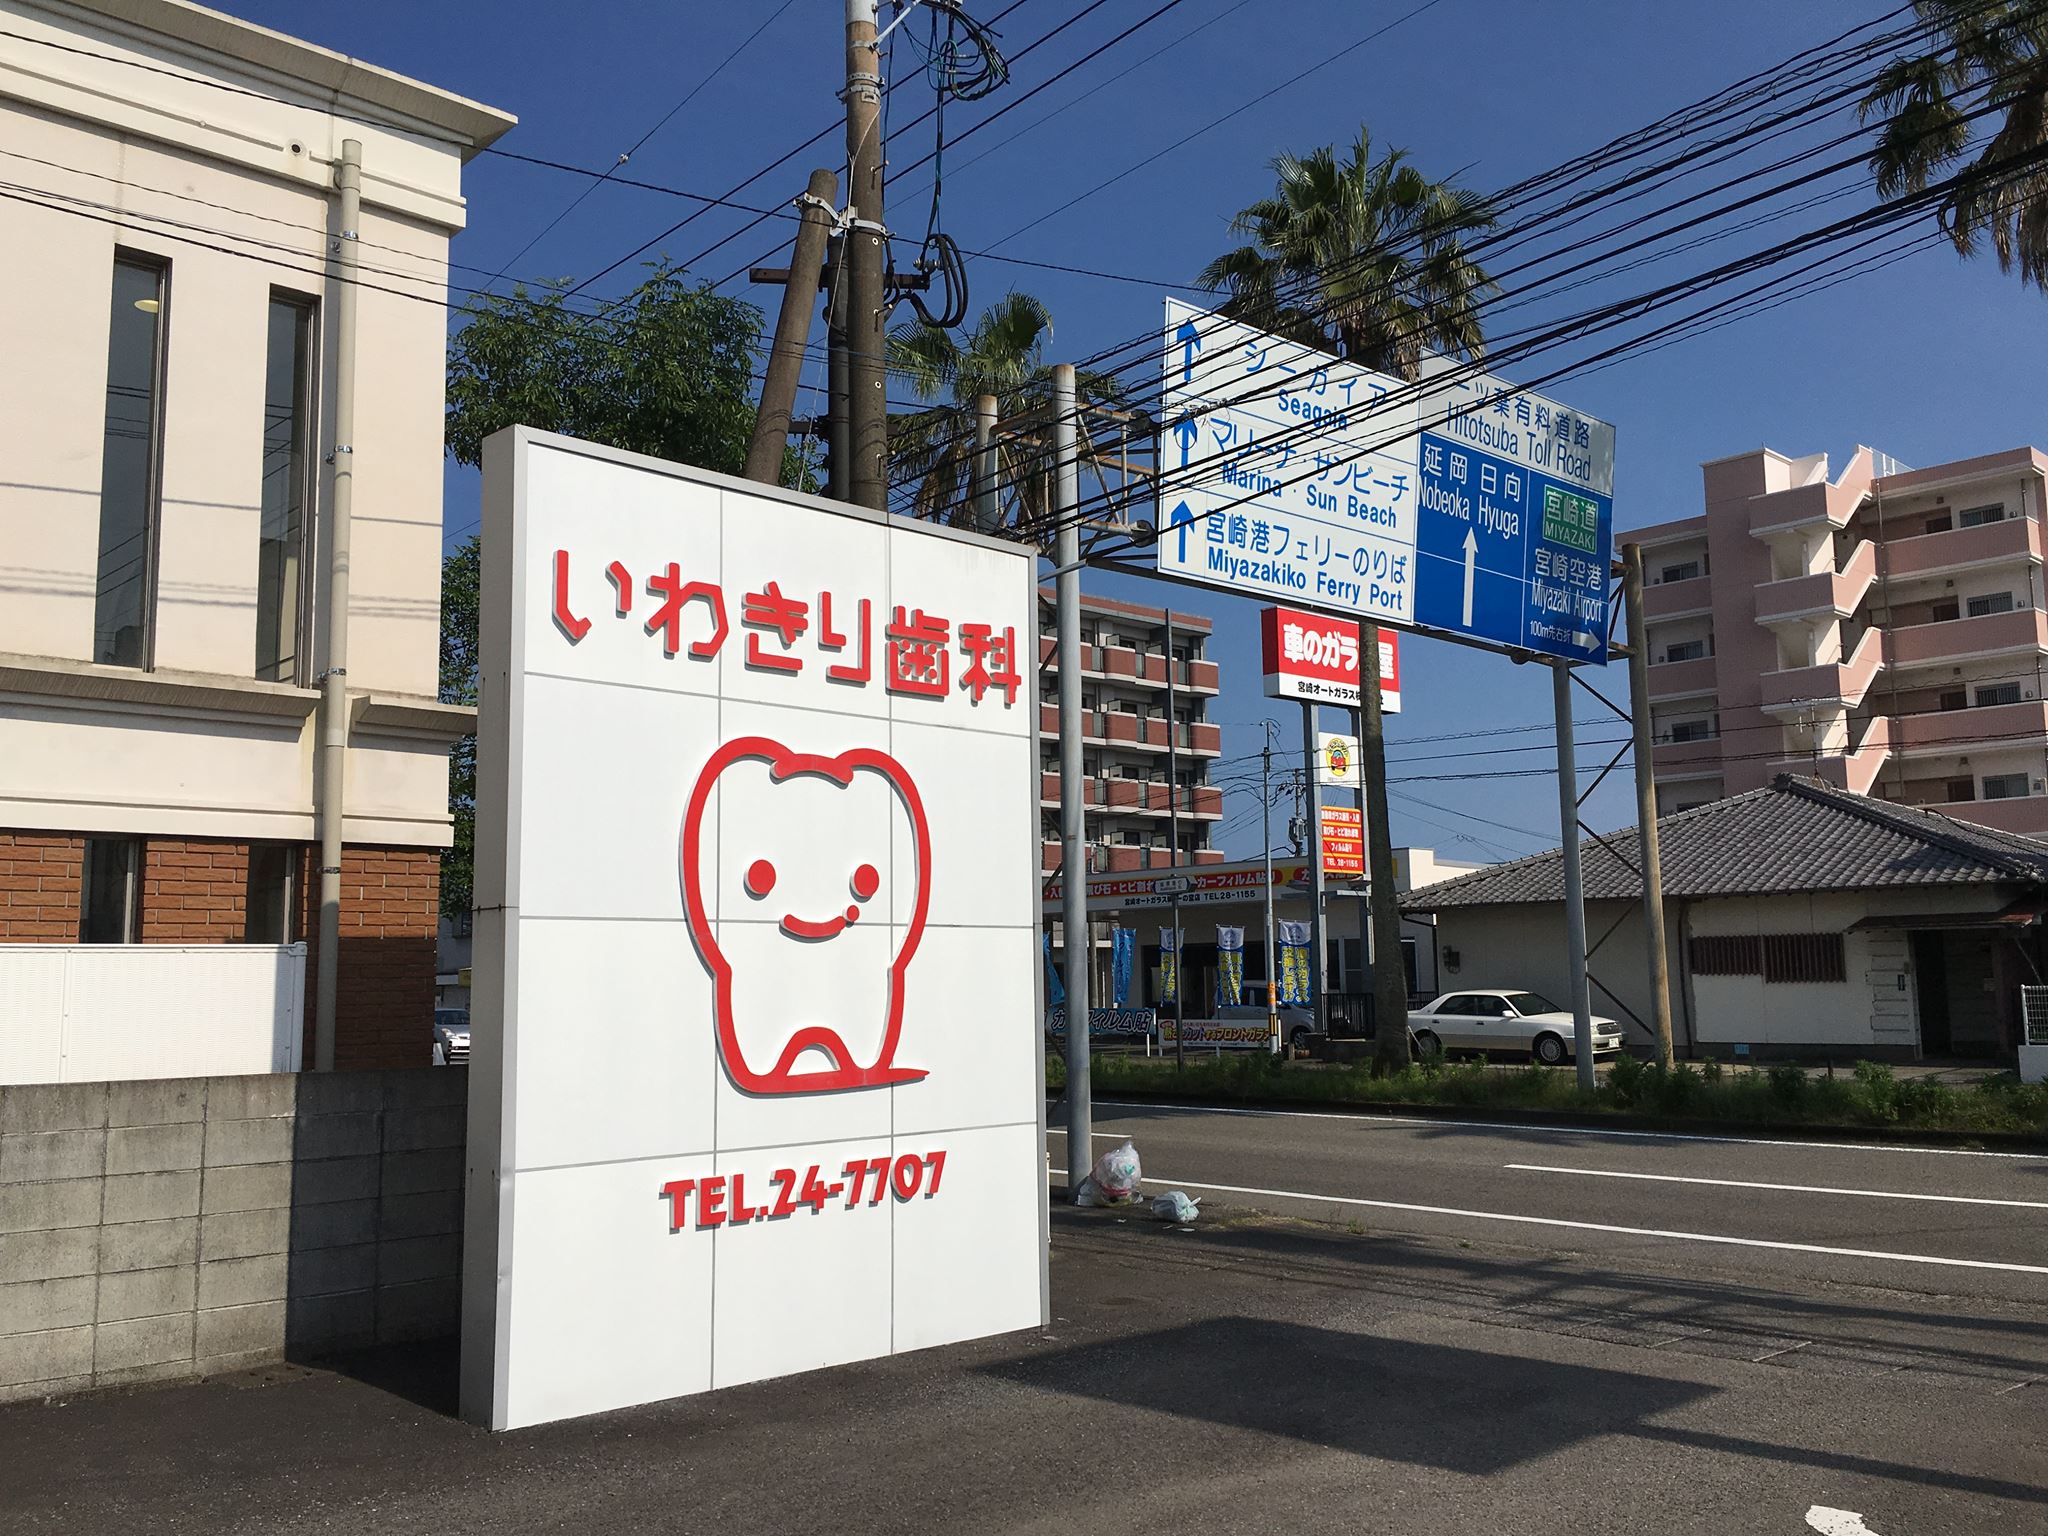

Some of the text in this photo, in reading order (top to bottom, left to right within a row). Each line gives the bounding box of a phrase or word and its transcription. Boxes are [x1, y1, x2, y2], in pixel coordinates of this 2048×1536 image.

[1244, 342, 1388, 408] シーガイア
[1278, 388, 1348, 432] Seagaia
[1447, 401, 1592, 482] Hitotsuba Toll Road
[1453, 378, 1591, 450] 一ツ葉有料道路
[1222, 459, 1282, 498] Marina
[1306, 484, 1337, 513] Sun
[1347, 494, 1397, 529] Beach
[1423, 443, 1521, 503] 延岡 日向
[1418, 474, 1519, 540] Nobeoka Hyuga
[1544, 520, 1596, 551] MIYAZAKI
[1545, 490, 1597, 533] 宮崎道
[1206, 509, 1408, 585] 宮崎港フェリーのりば
[1207, 546, 1403, 611] Miyazakiko Ferry Port
[1534, 547, 1602, 592] 宮崎空港
[552, 549, 1022, 705] いわきり歯科
[1531, 576, 1602, 625] Miyazaki Airport
[1283, 622, 1395, 680] 車のガラ屋
[659, 1151, 947, 1232] TEL.24-7707
